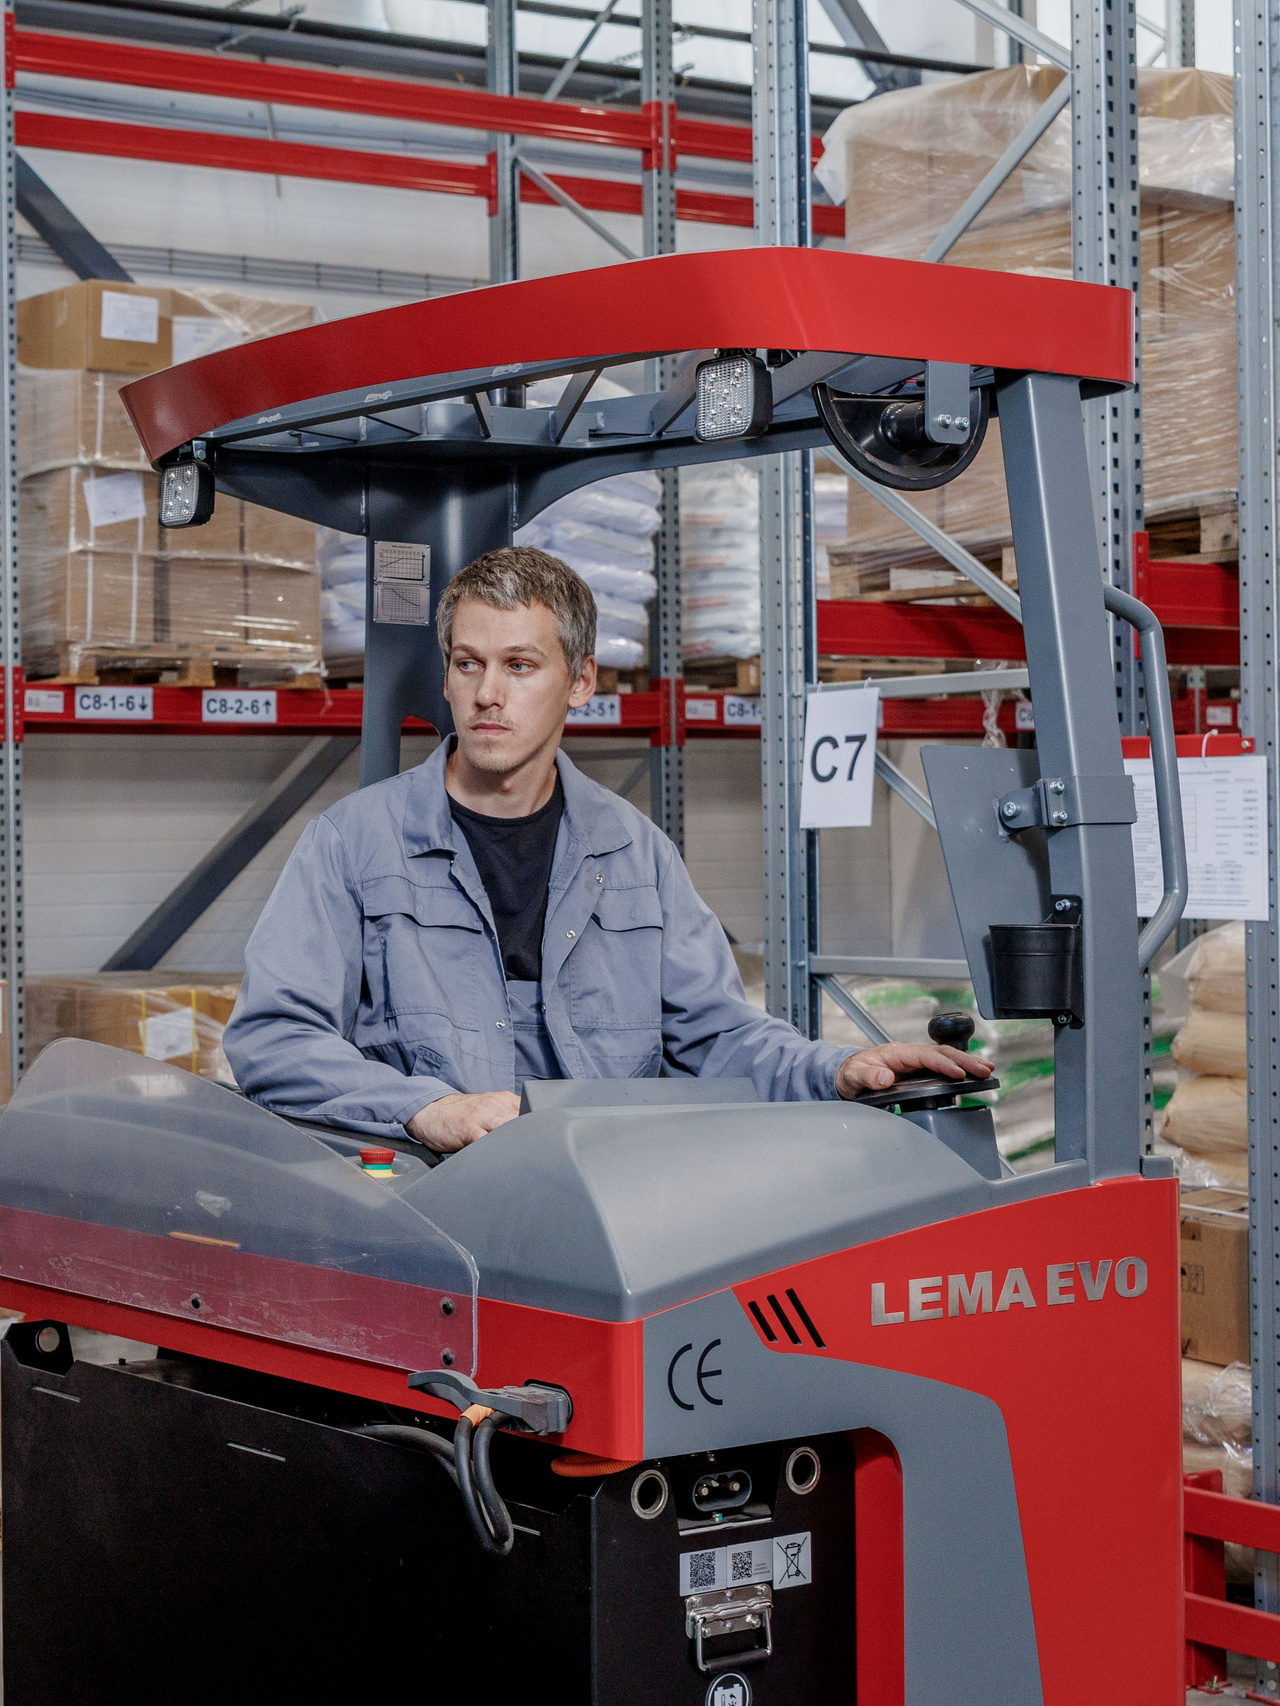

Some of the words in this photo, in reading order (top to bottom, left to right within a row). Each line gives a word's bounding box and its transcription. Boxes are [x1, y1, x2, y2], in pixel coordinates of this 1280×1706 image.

[79, 693, 135, 710] C8-1-6
[206, 698, 260, 714] C8-2-6
[809, 733, 867, 783] C7
[870, 1267, 1037, 1327] LEMA
[1046, 1255, 1149, 1307] EVO
